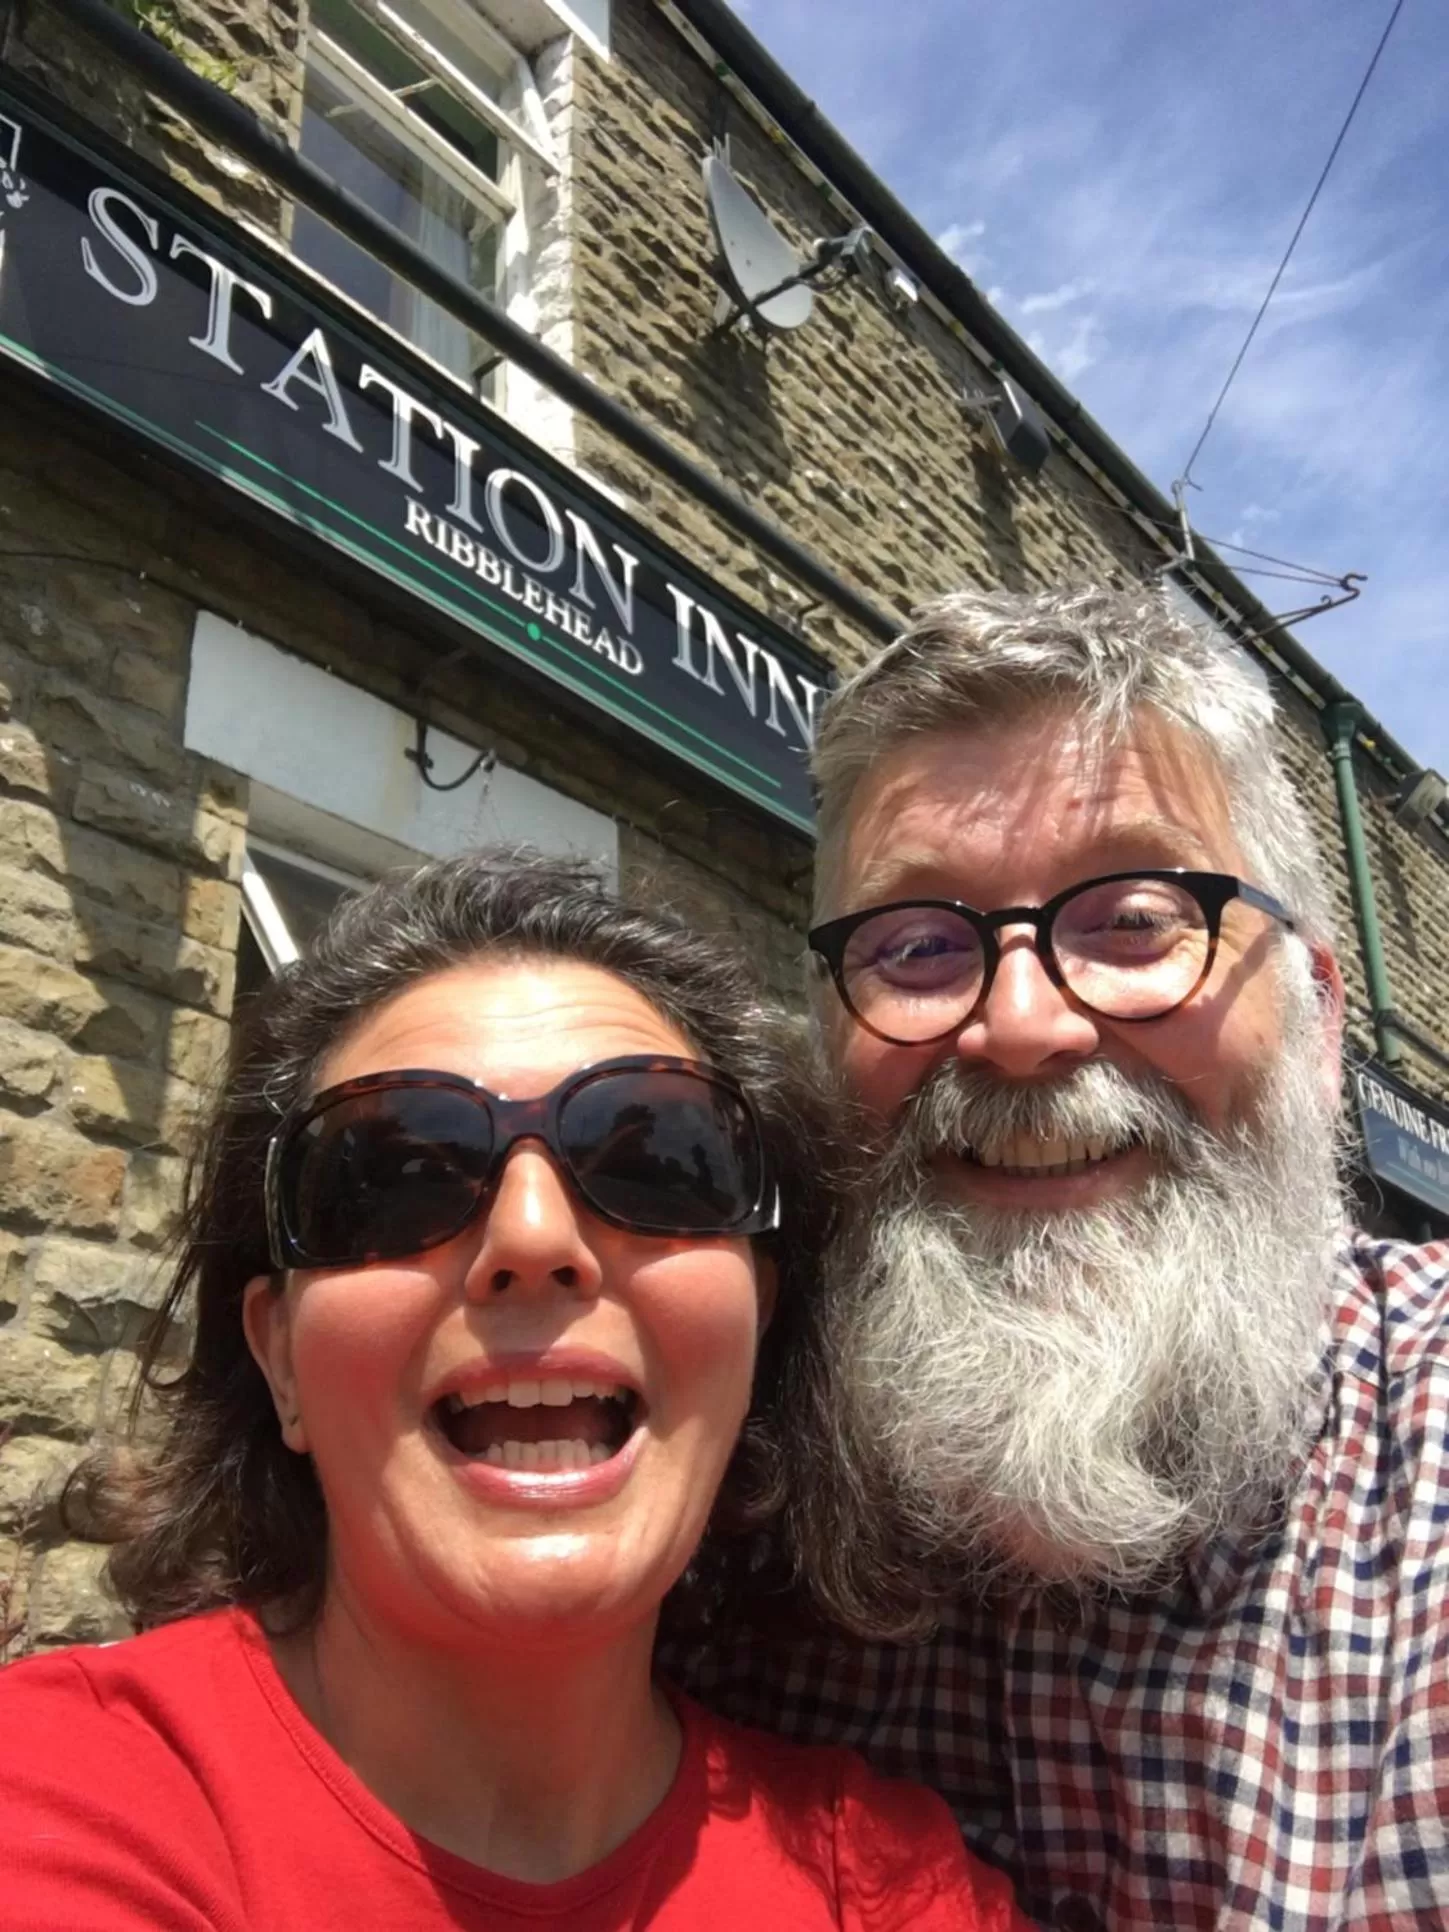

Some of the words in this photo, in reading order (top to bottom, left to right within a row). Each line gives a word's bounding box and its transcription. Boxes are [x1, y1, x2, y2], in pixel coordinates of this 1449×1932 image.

[81, 186, 640, 636] STATION
[666, 582, 818, 752] INN
[403, 495, 645, 676] RIBBLEHEAD
[1357, 1072, 1431, 1145] GENUINE
[1428, 1117, 1449, 1156] FR
